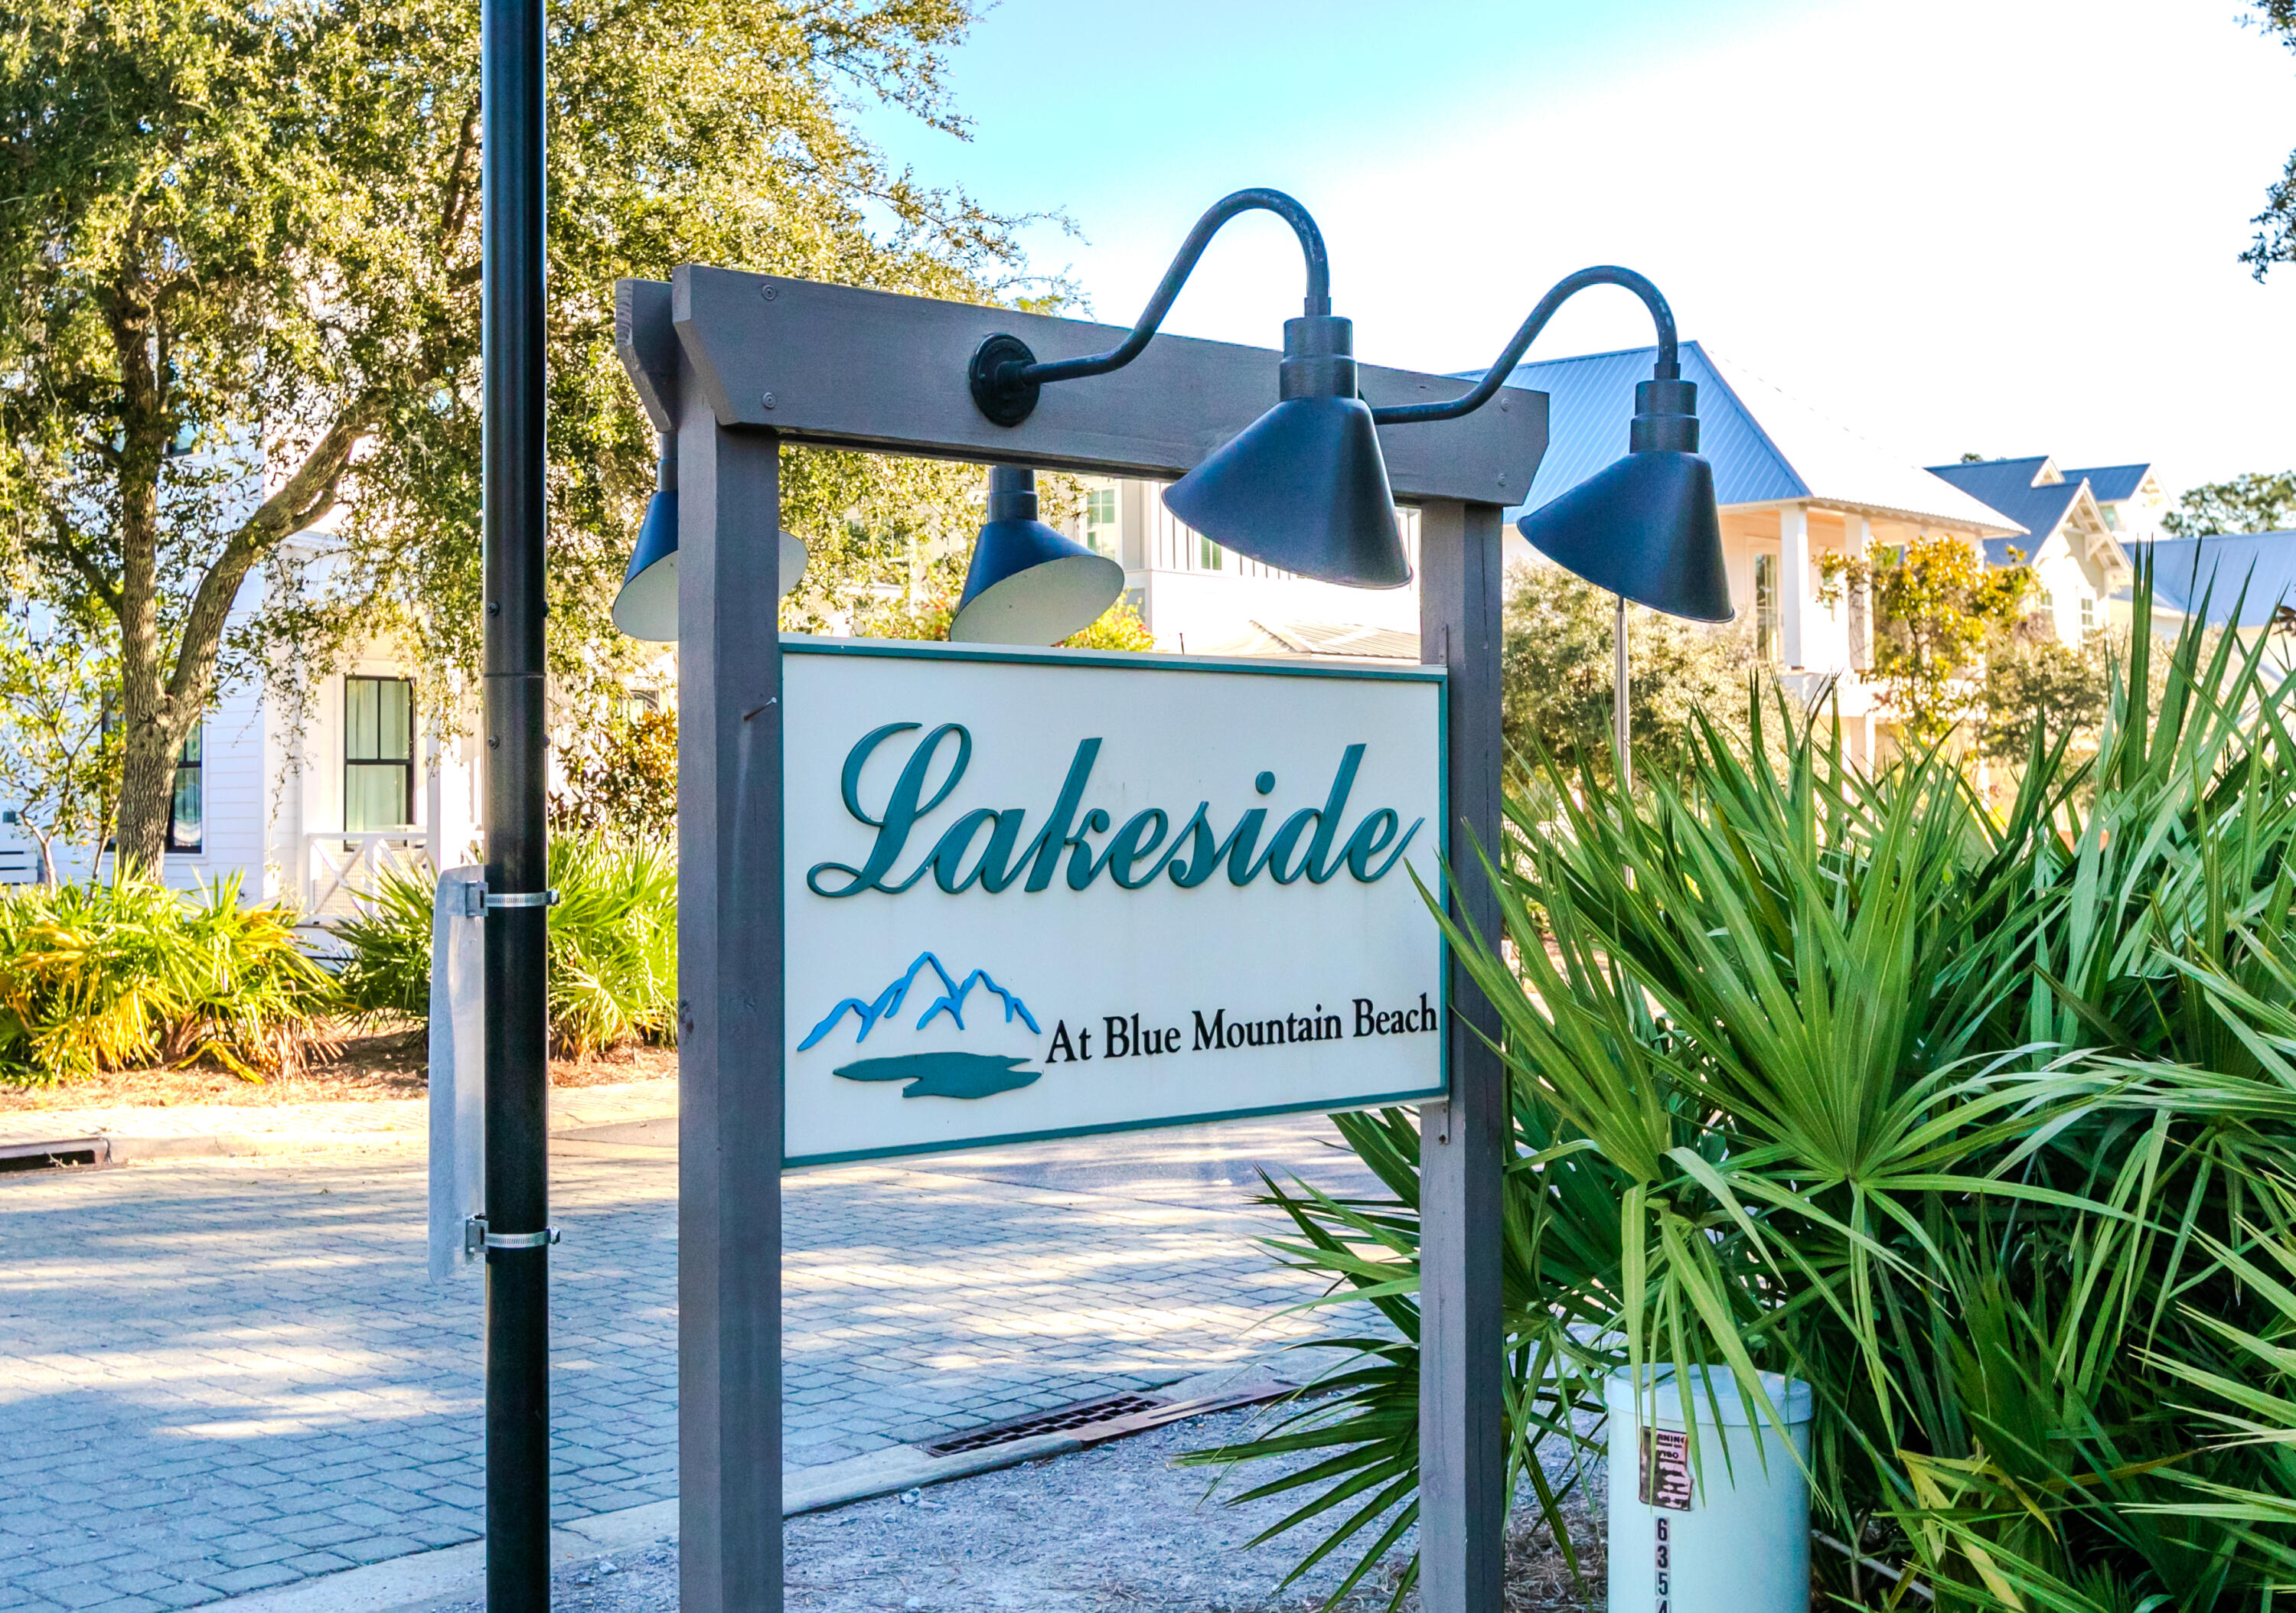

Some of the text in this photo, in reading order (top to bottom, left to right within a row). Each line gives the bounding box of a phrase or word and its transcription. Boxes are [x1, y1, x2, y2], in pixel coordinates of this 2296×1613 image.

[807, 722, 1426, 899] Lakeside
[1045, 992, 1438, 1064] At Blue Mountain Beach
